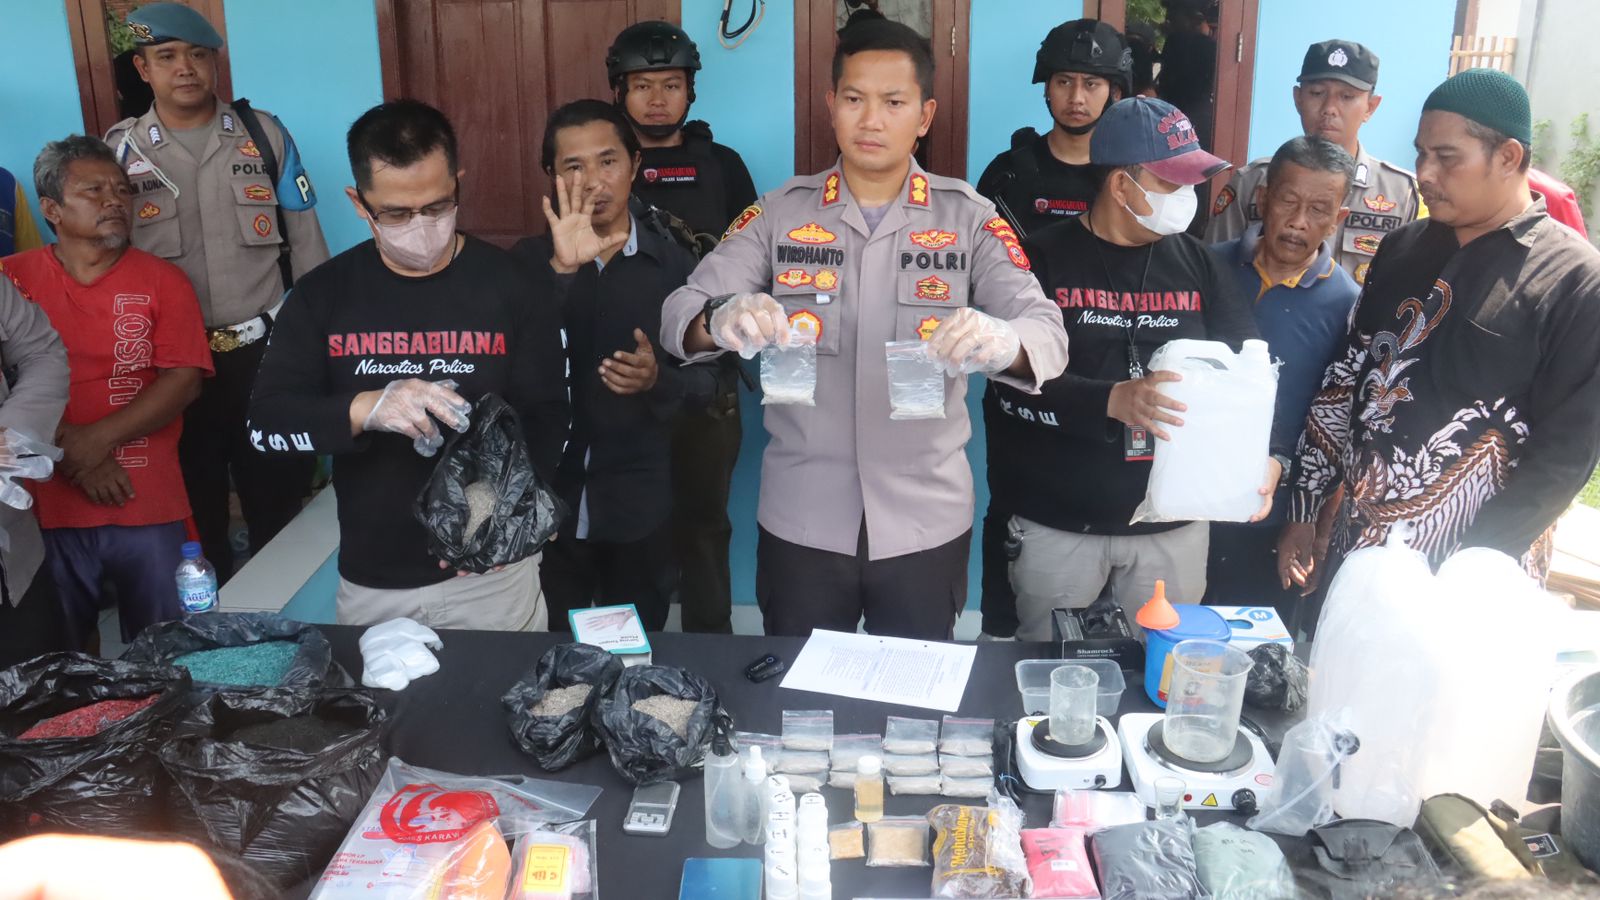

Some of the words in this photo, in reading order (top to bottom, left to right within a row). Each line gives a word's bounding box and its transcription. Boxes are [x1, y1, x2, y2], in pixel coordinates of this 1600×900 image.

[232, 163, 269, 176] POLR
[1350, 214, 1397, 230] POLRI
[777, 244, 844, 266] WIRDHANTO
[900, 252, 967, 270] POLRI
[1055, 287, 1201, 312] SANGGABUANA
[1077, 310, 1133, 328] Narcotics
[1137, 314, 1179, 328] Police
[328, 331, 507, 357] SANGGABUANA
[354, 359, 424, 375] Narcotics
[429, 359, 475, 375] Police
[1253, 611, 1269, 620] M
[1076, 647, 1115, 655] Shamrock
